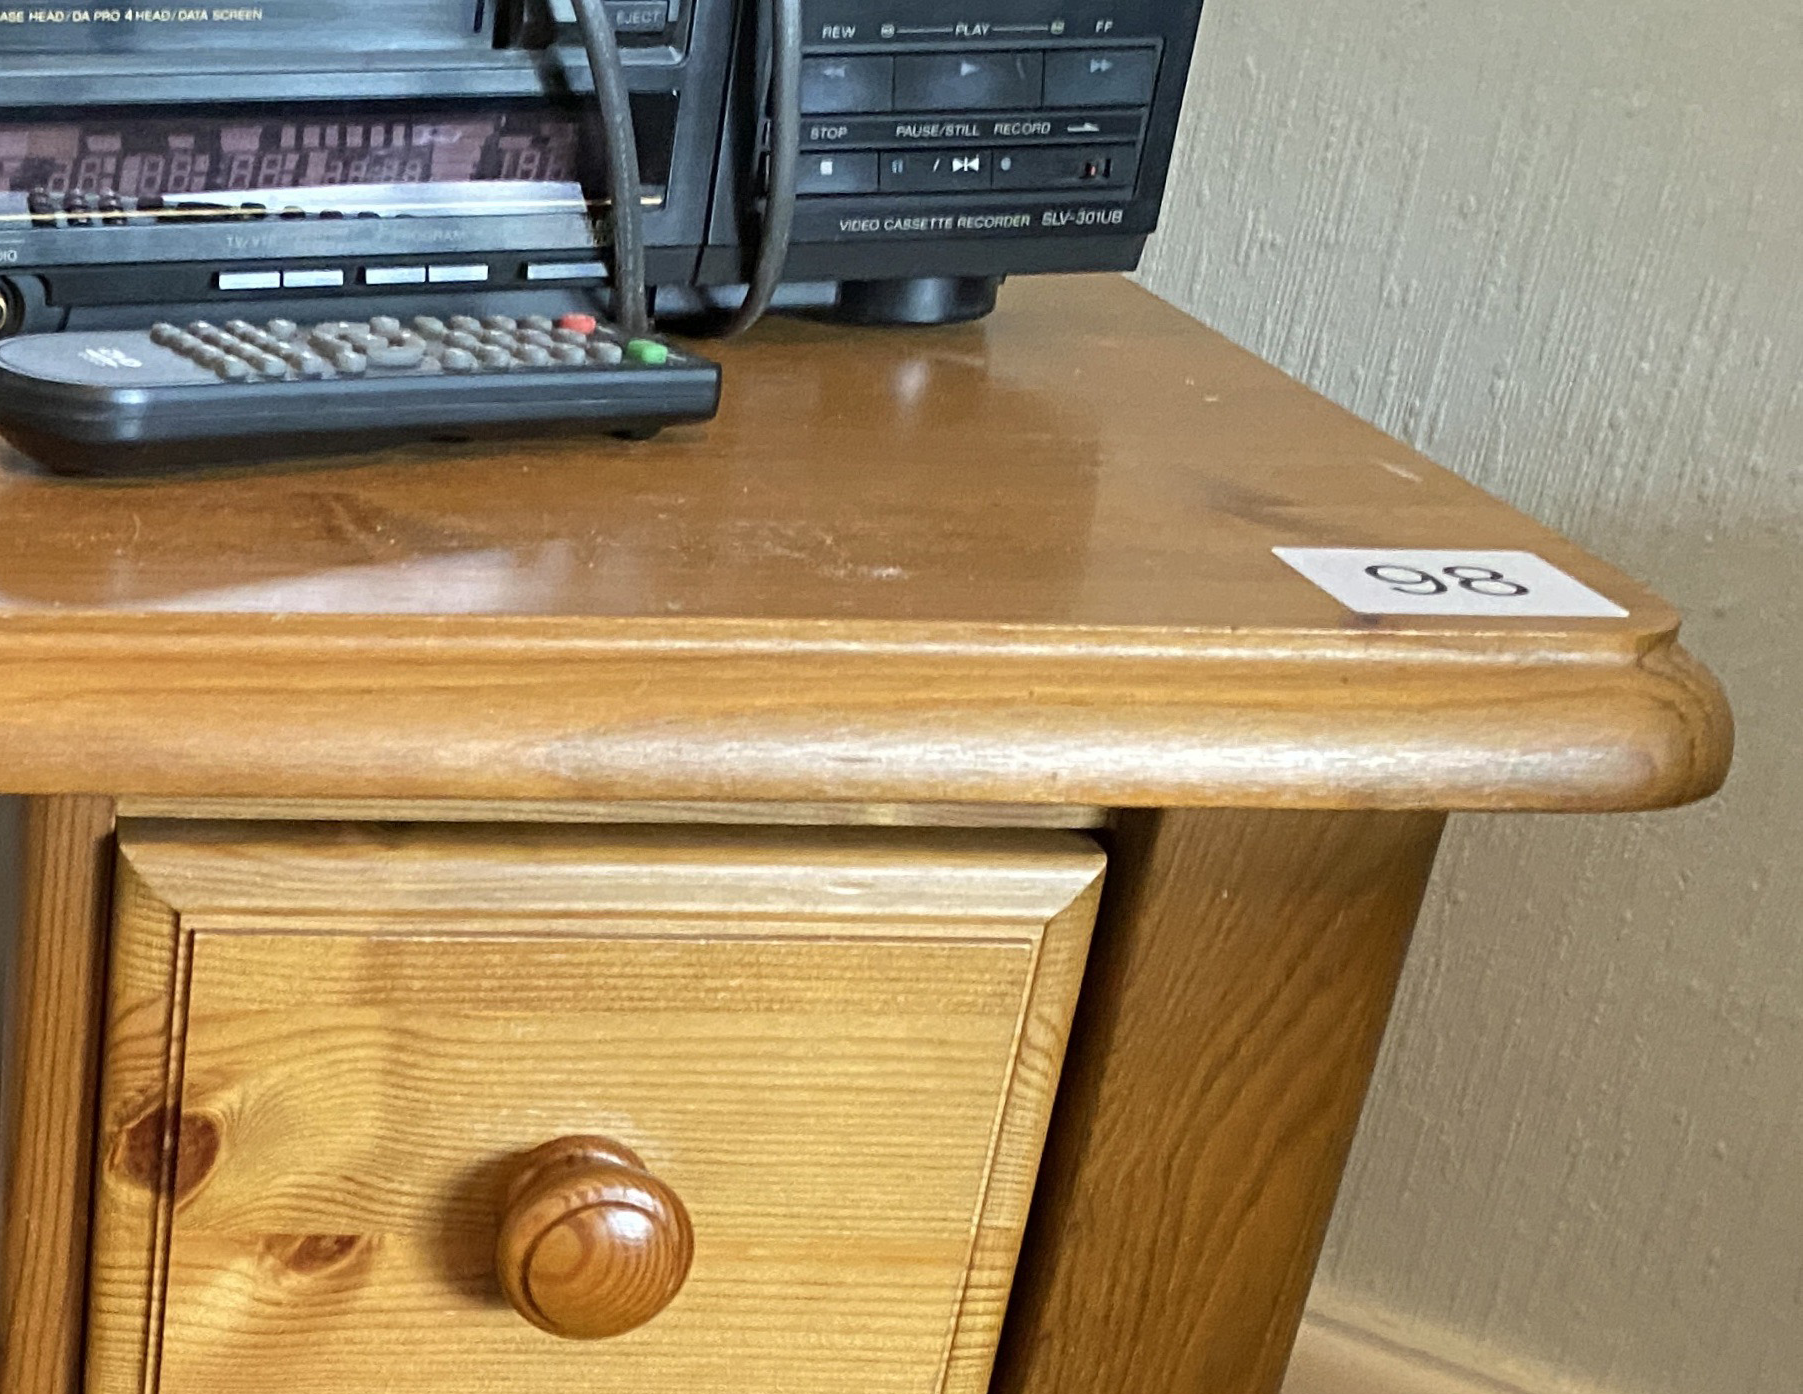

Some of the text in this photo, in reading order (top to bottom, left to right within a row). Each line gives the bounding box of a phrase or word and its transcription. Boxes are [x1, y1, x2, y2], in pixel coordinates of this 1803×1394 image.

[93, 10, 121, 22] PRO
[124, 8, 133, 21] 4
[212, 8, 263, 21] SCREEN
[822, 25, 856, 39] REW
[954, 22, 991, 37] PLAY
[1095, 20, 1113, 33] FF
[810, 126, 848, 140] STOP
[896, 123, 980, 139] PAUSE/STILL
[993, 121, 1051, 136] RECORD
[839, 219, 880, 232] VIDEO
[883, 217, 953, 231] CASSETTE
[957, 215, 1031, 230] RECORDER
[1364, 564, 1529, 596] 98
